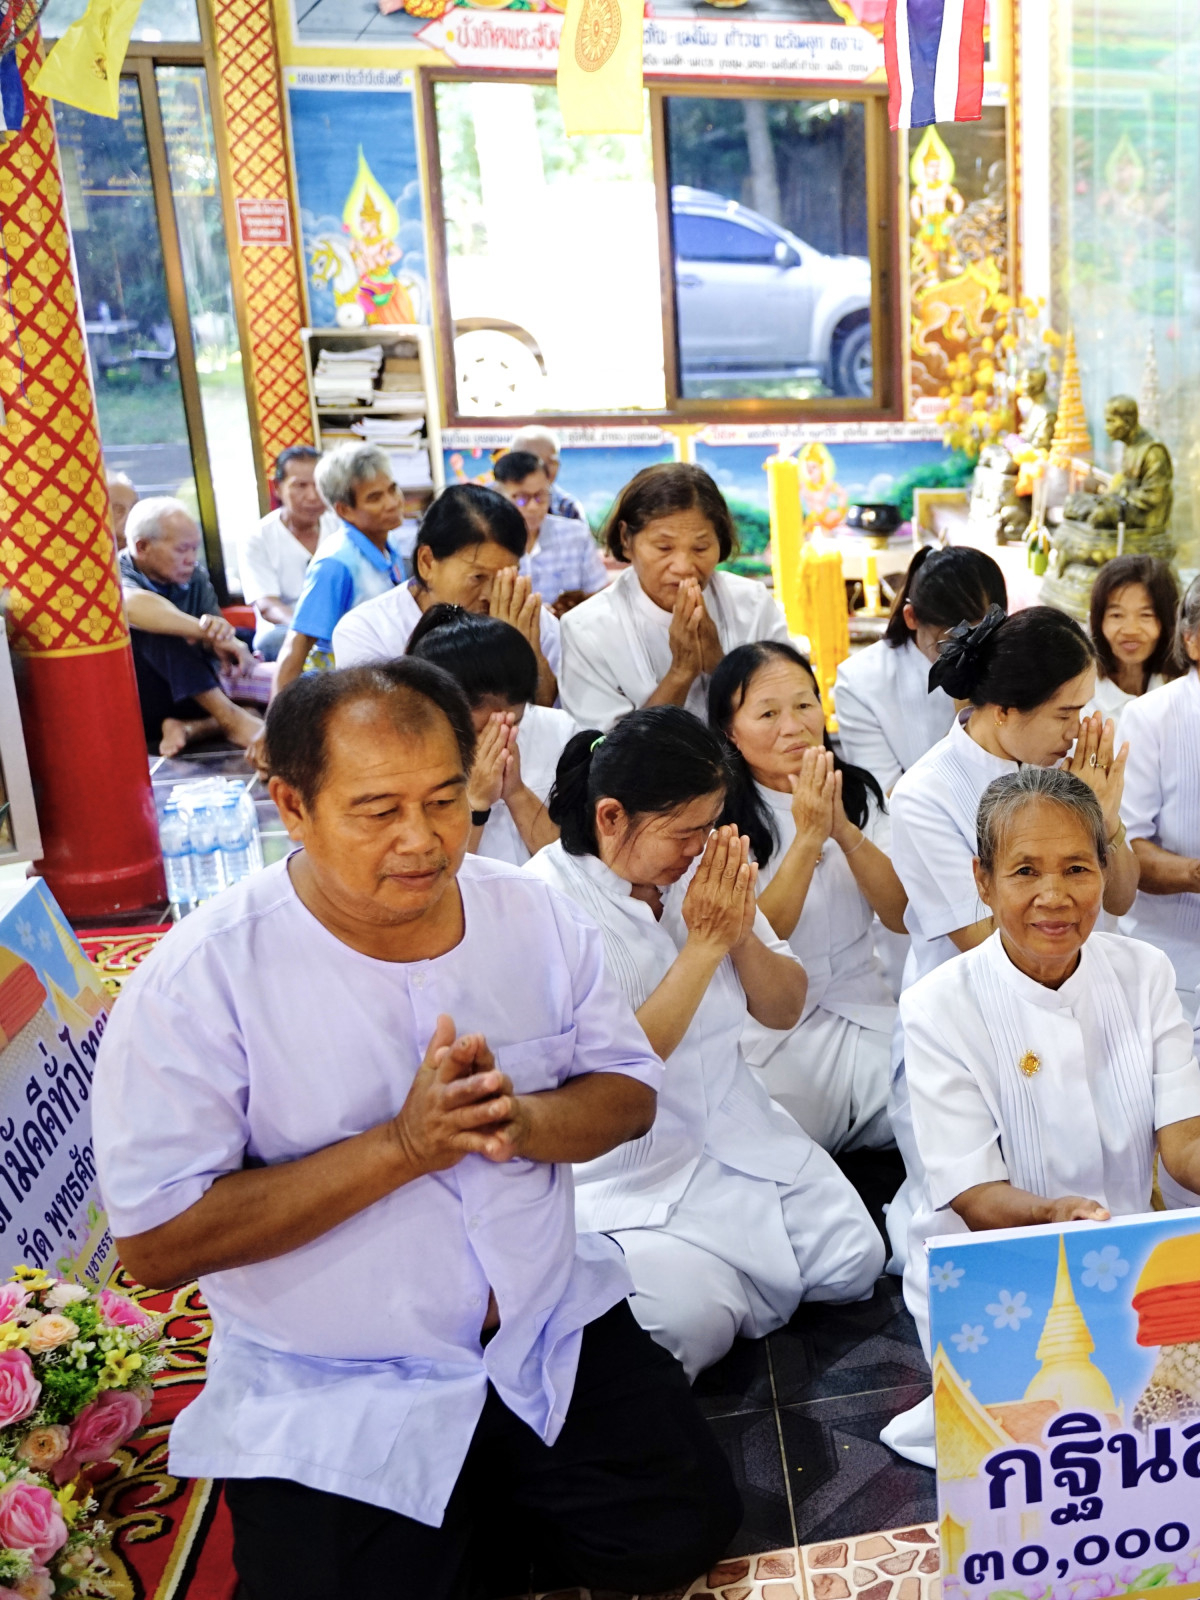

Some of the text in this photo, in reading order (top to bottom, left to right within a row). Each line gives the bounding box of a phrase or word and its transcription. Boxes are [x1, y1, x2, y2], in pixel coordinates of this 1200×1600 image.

[44, 1136, 97, 1241] พุทธศัก
[85, 1227, 113, 1284] บูชาธรร
[963, 1521, 1191, 1584] ๓๐,๐๐๐
